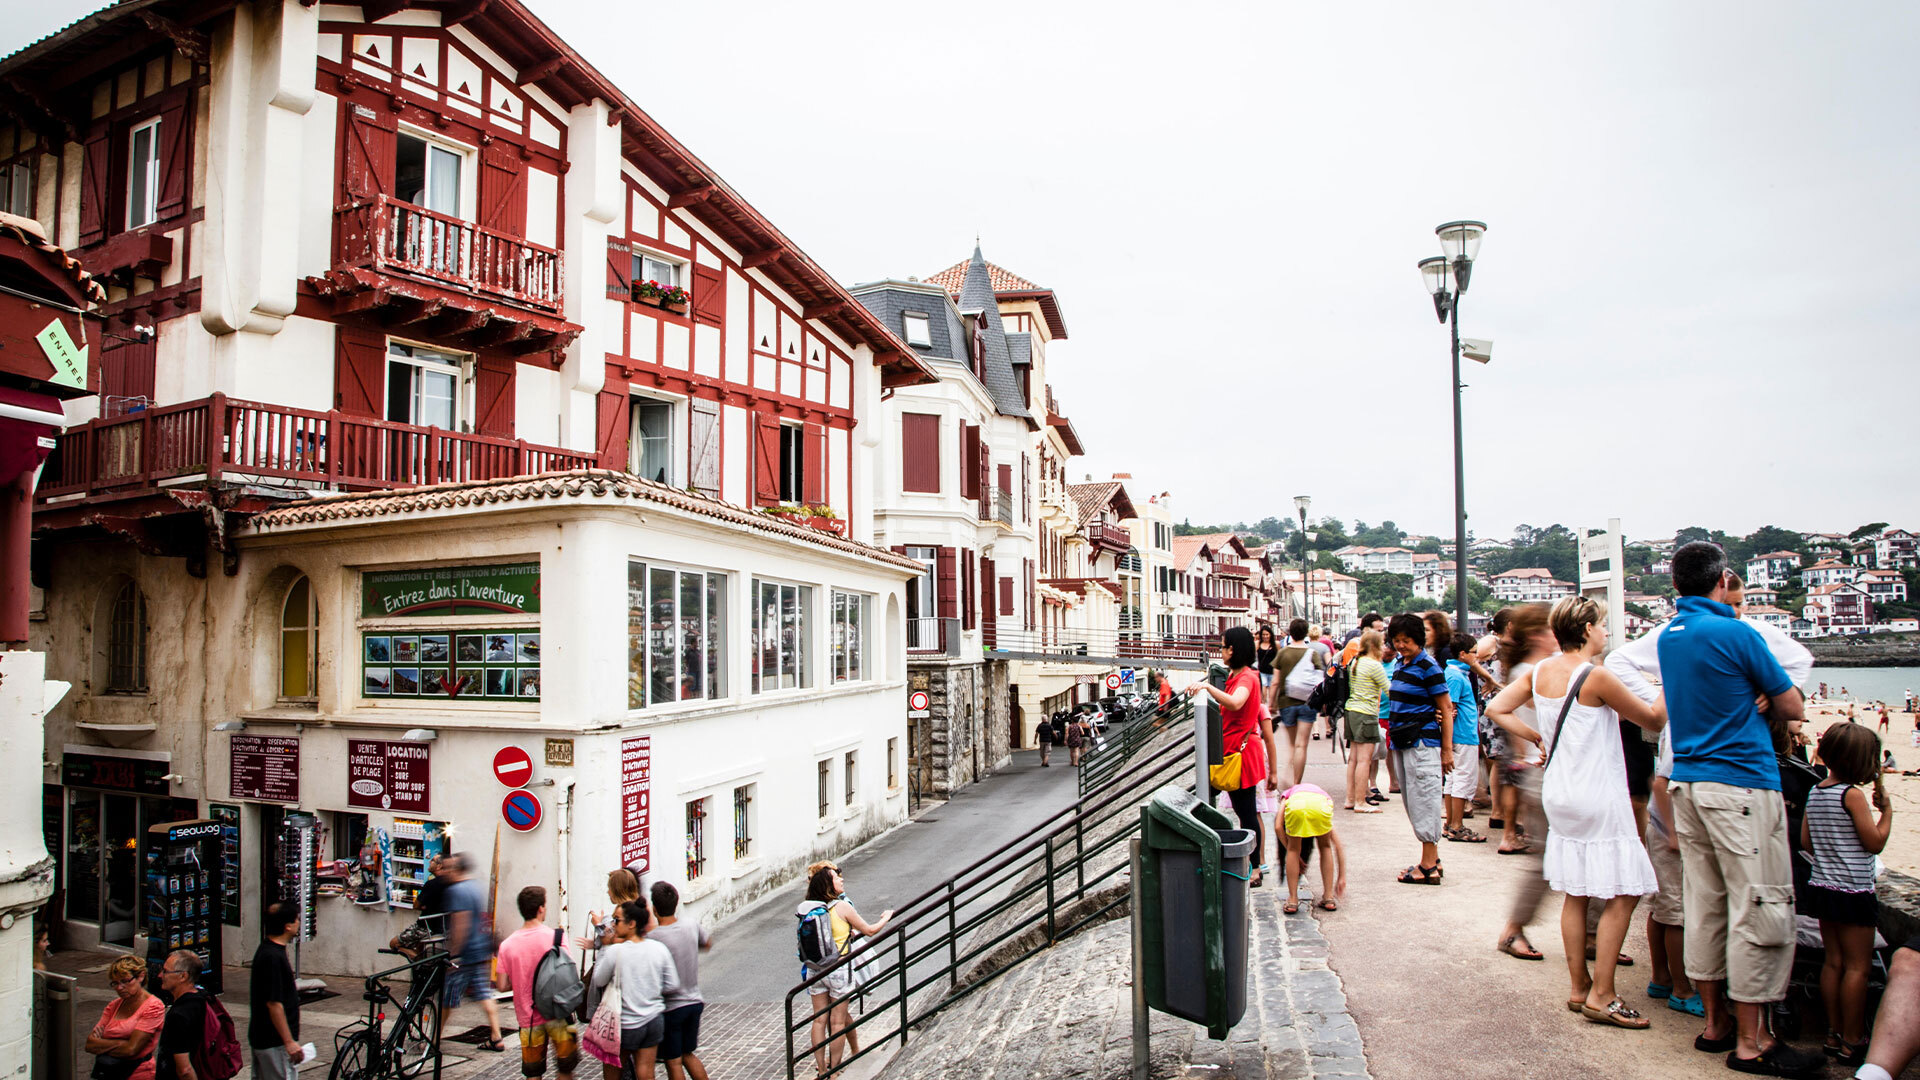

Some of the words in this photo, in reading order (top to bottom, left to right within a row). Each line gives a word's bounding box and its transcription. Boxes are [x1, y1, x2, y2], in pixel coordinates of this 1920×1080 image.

[48, 331, 84, 384] ENTREE
[371, 573, 422, 583] INFORMATION
[423, 572, 433, 580] ET
[383, 589, 426, 613] Entrez
[428, 579, 457, 600] dans
[461, 578, 526, 609] l'aventure
[357, 744, 377, 754] VENTE
[387, 746, 428, 760] LOCATION
[350, 755, 384, 766] D'ARTICLES
[394, 761, 409, 770] V.T.T
[353, 766, 361, 776] DE
[362, 767, 382, 777] PLAGE
[395, 771, 409, 780] SURF
[395, 781, 410, 791] BODY
[410, 782, 425, 791] SURF
[622, 781, 650, 796] LOCATION
[395, 791, 412, 801] STAND
[413, 792, 422, 801] UP
[176, 824, 220, 837] seawag
[628, 831, 644, 842] VENTE
[622, 838, 649, 853] D'ARTICLES
[624, 852, 632, 861] DE
[632, 847, 647, 858] PLAGE
